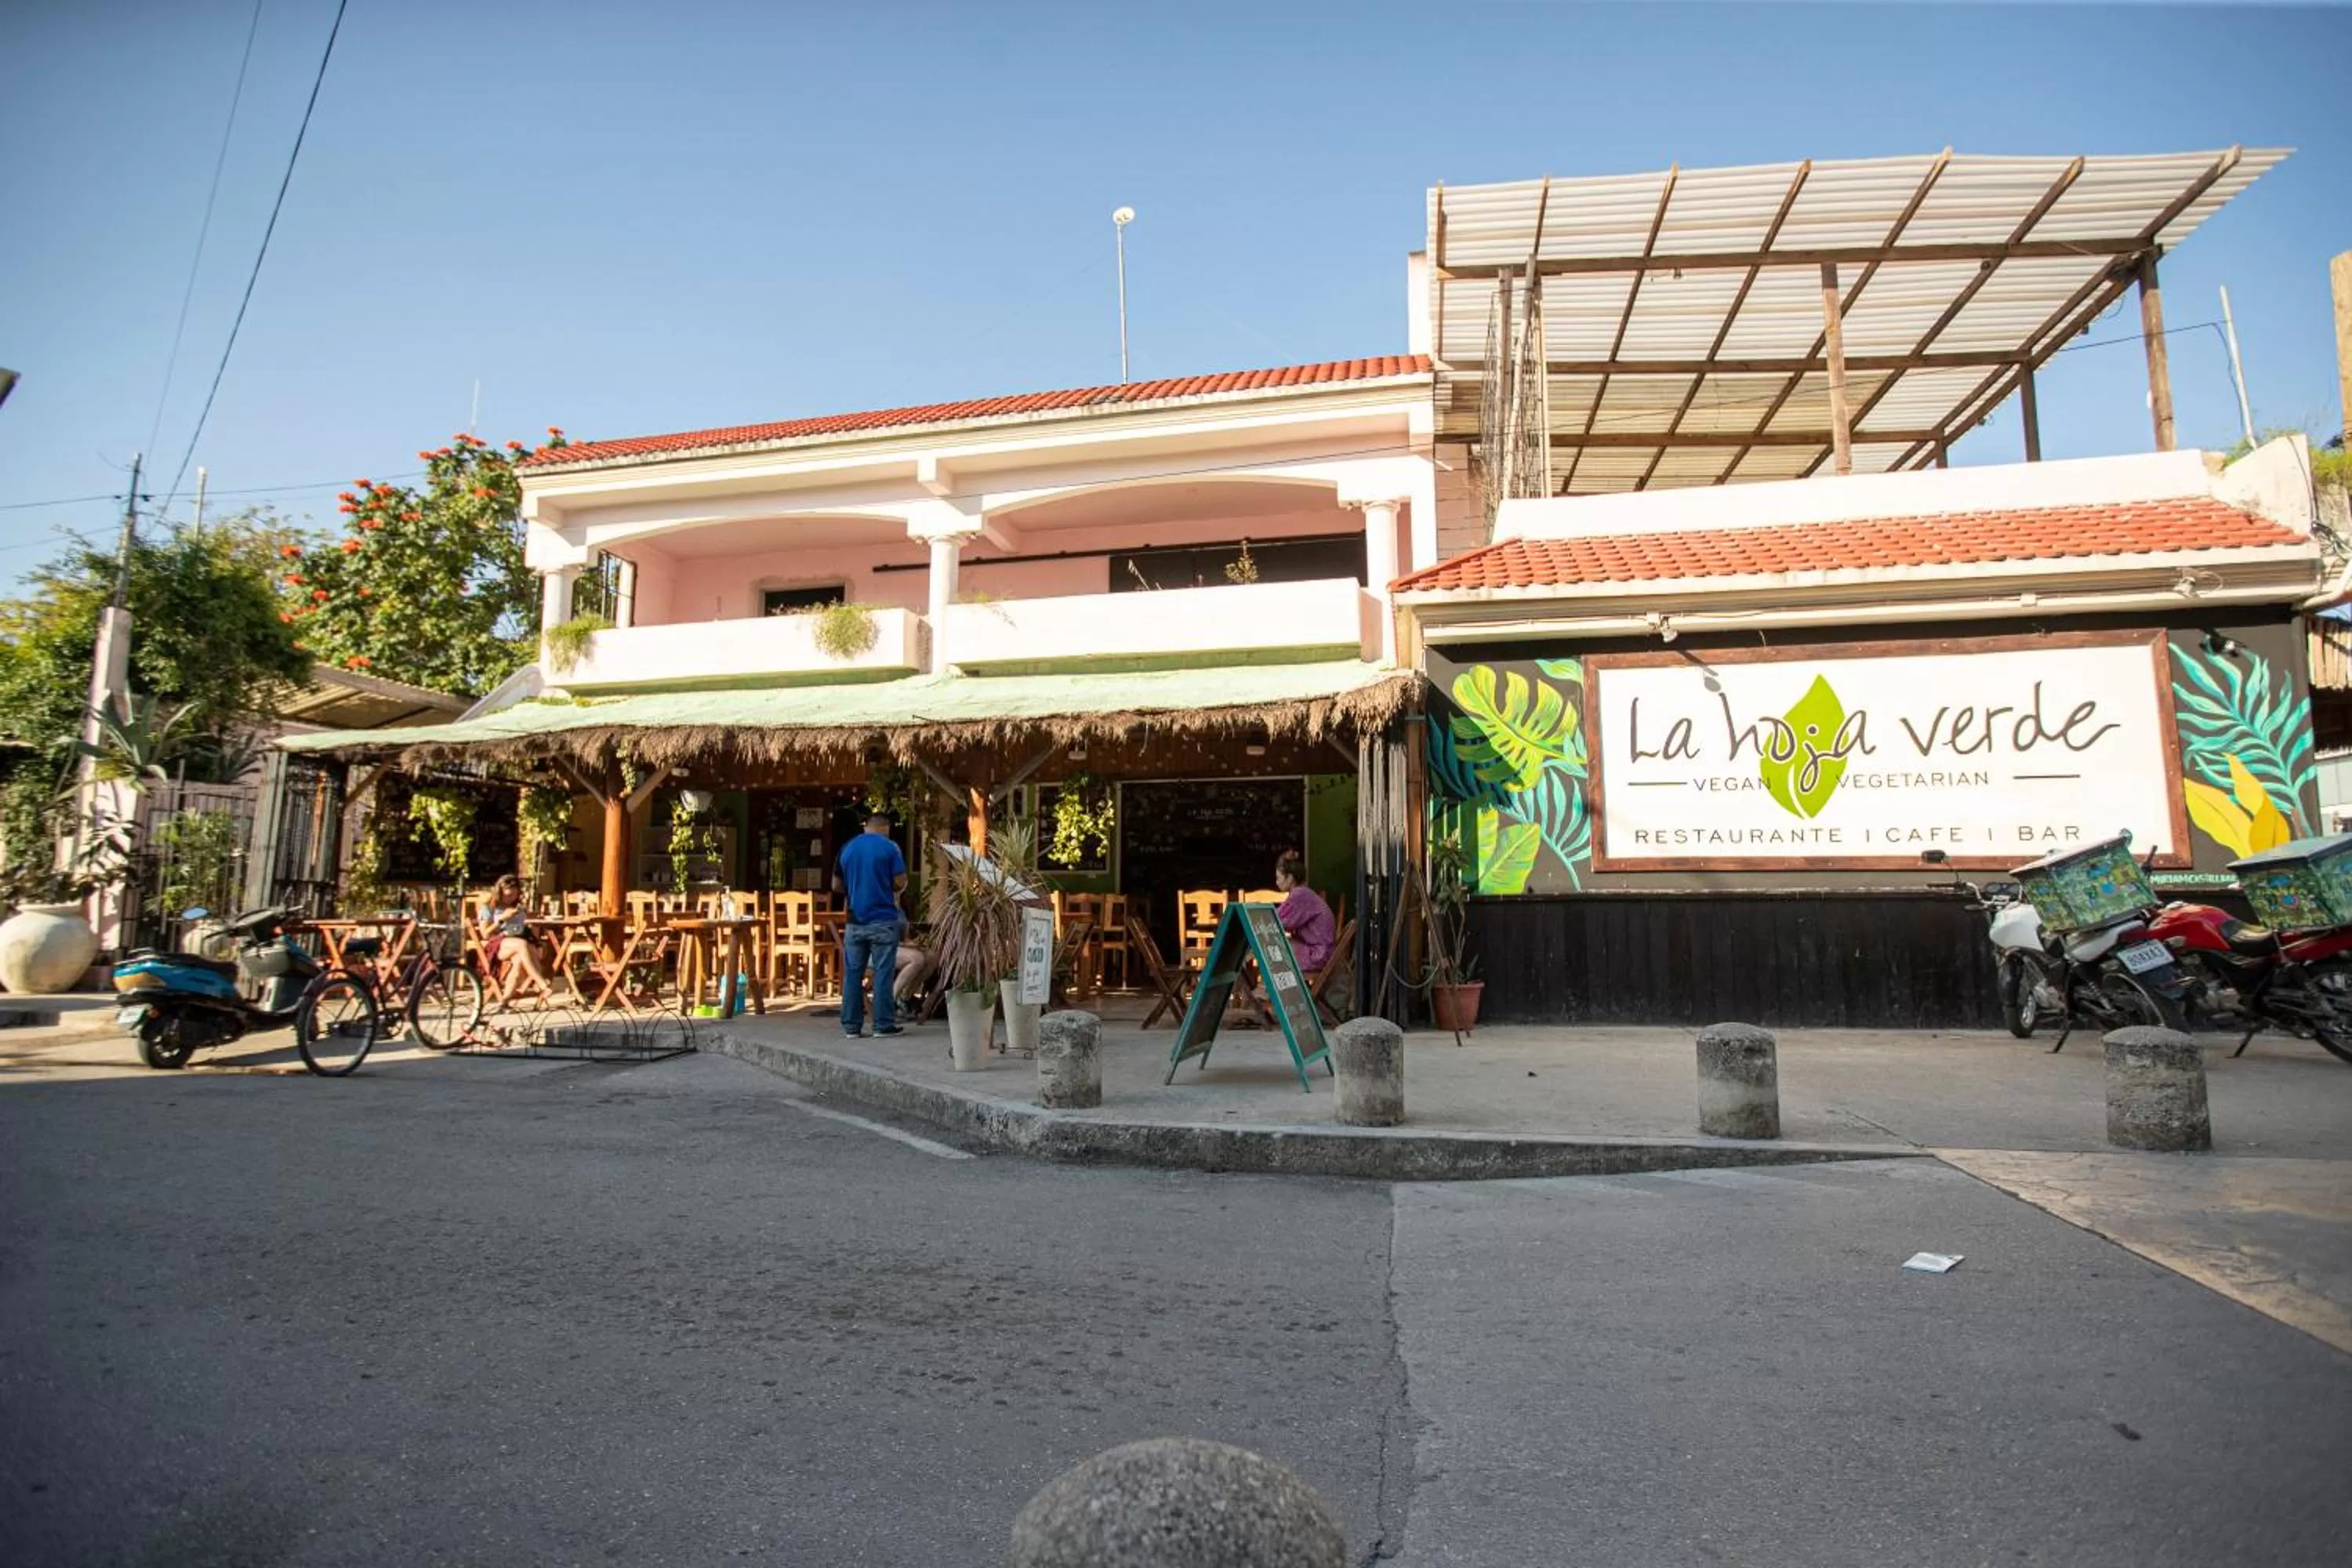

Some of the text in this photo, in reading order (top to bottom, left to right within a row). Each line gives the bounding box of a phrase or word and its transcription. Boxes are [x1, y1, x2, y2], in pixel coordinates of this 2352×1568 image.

[1630, 681, 2121, 793] La hoja verde
[1693, 771, 1989, 791] VEGAN VEGETARIAN
[1635, 828, 1843, 844] RESTAURANTE
[1886, 827, 1964, 843] CAFE
[2018, 825, 2081, 841] BAR
